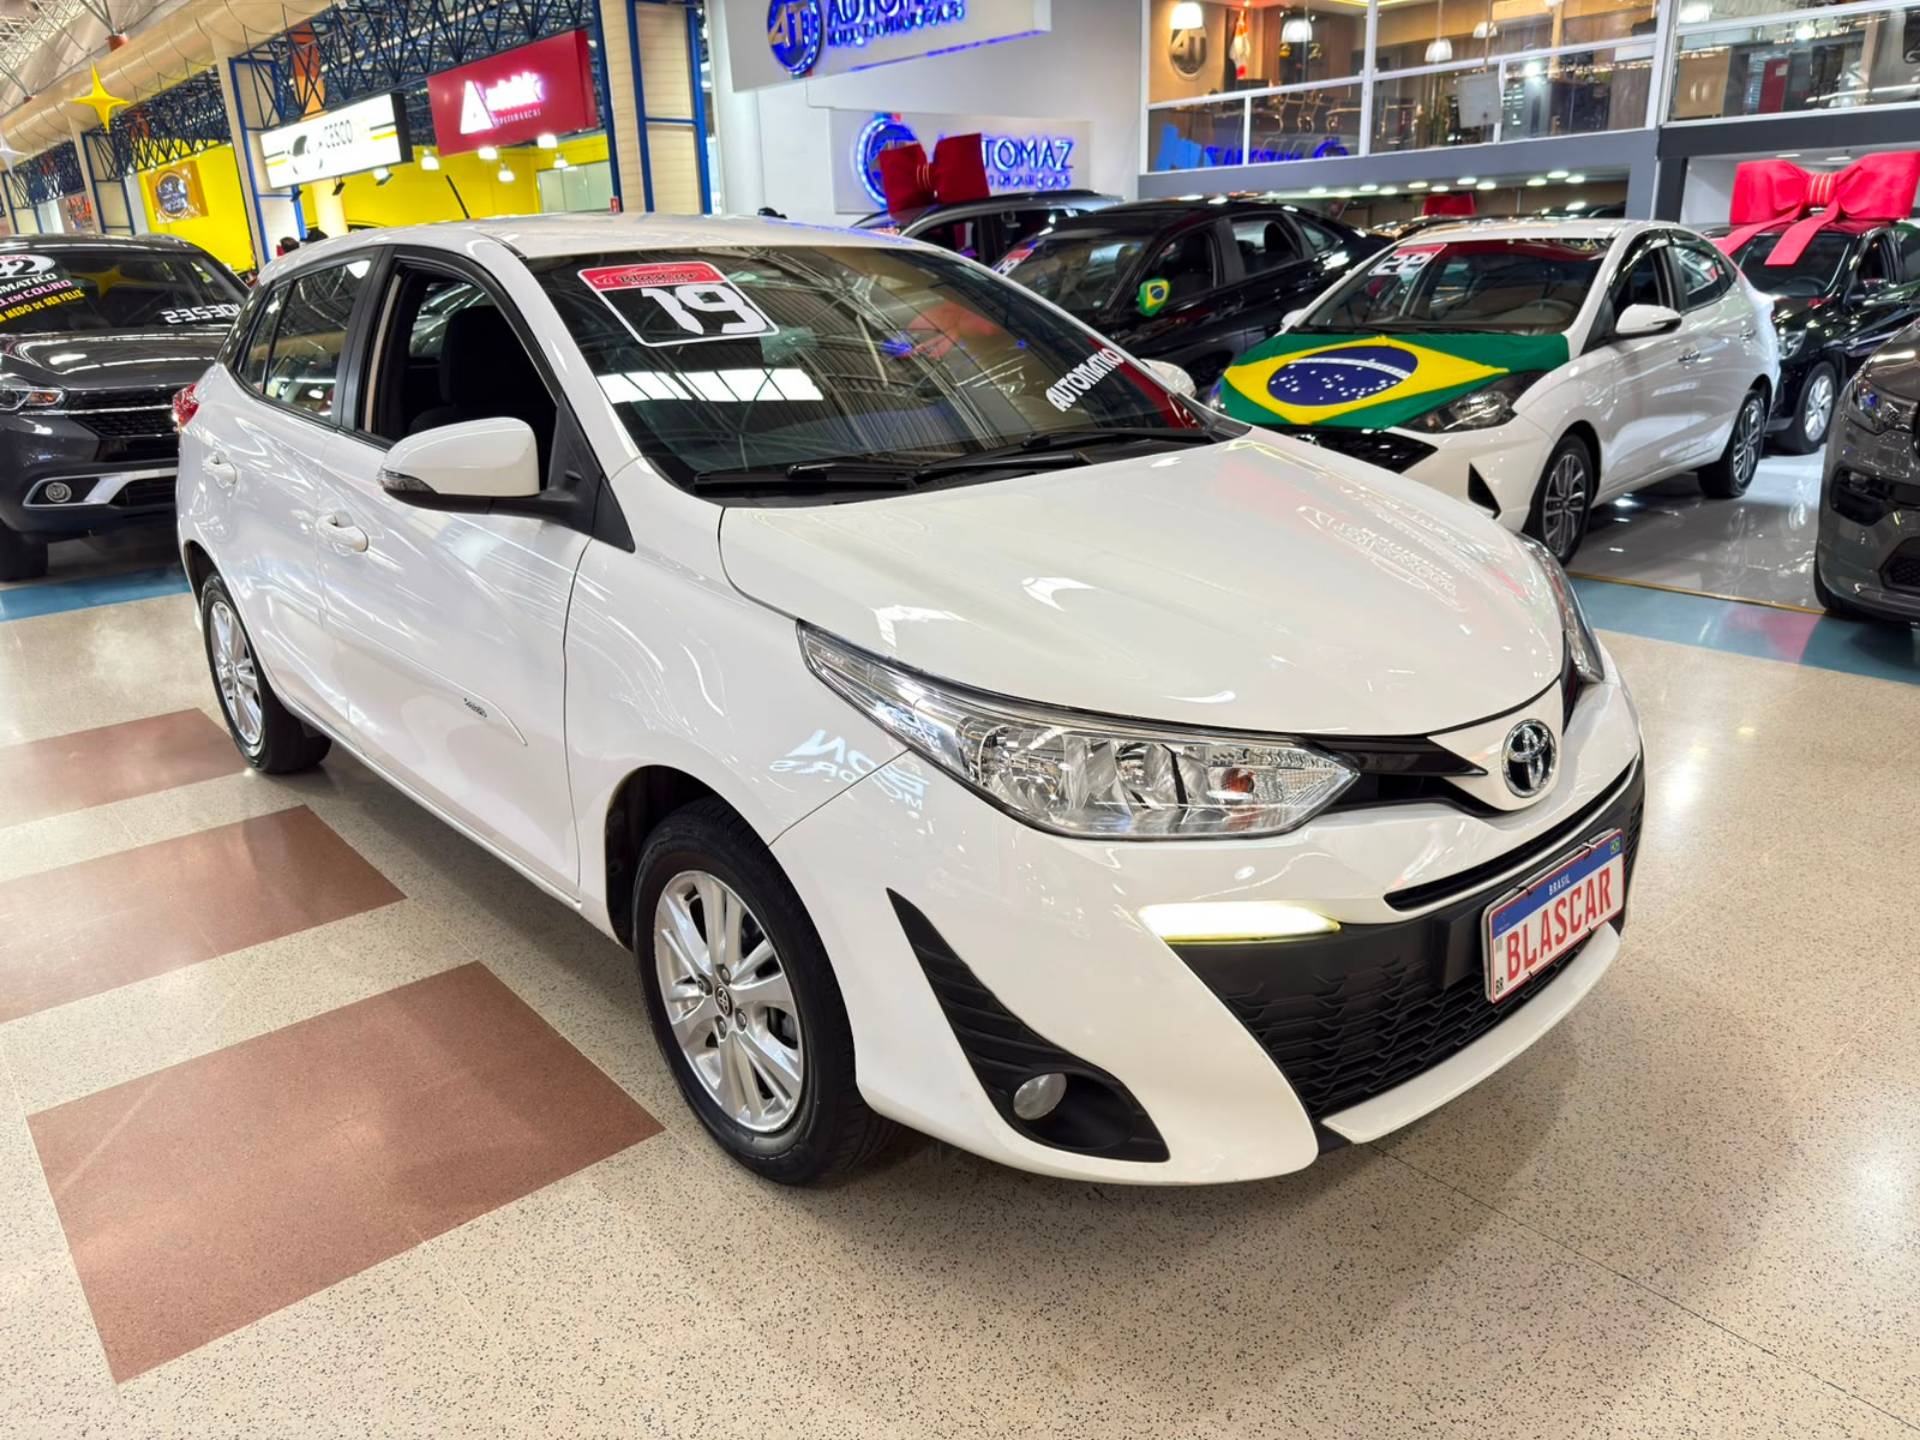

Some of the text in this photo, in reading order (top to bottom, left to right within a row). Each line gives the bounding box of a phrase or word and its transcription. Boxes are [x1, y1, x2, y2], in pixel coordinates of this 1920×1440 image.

[981, 137, 1074, 172] TOMAZ
[22, 279, 73, 298] COURO
[641, 282, 768, 335] 19
[1548, 873, 1572, 897] BRASIL
[1506, 866, 1613, 983] BLASCAR
